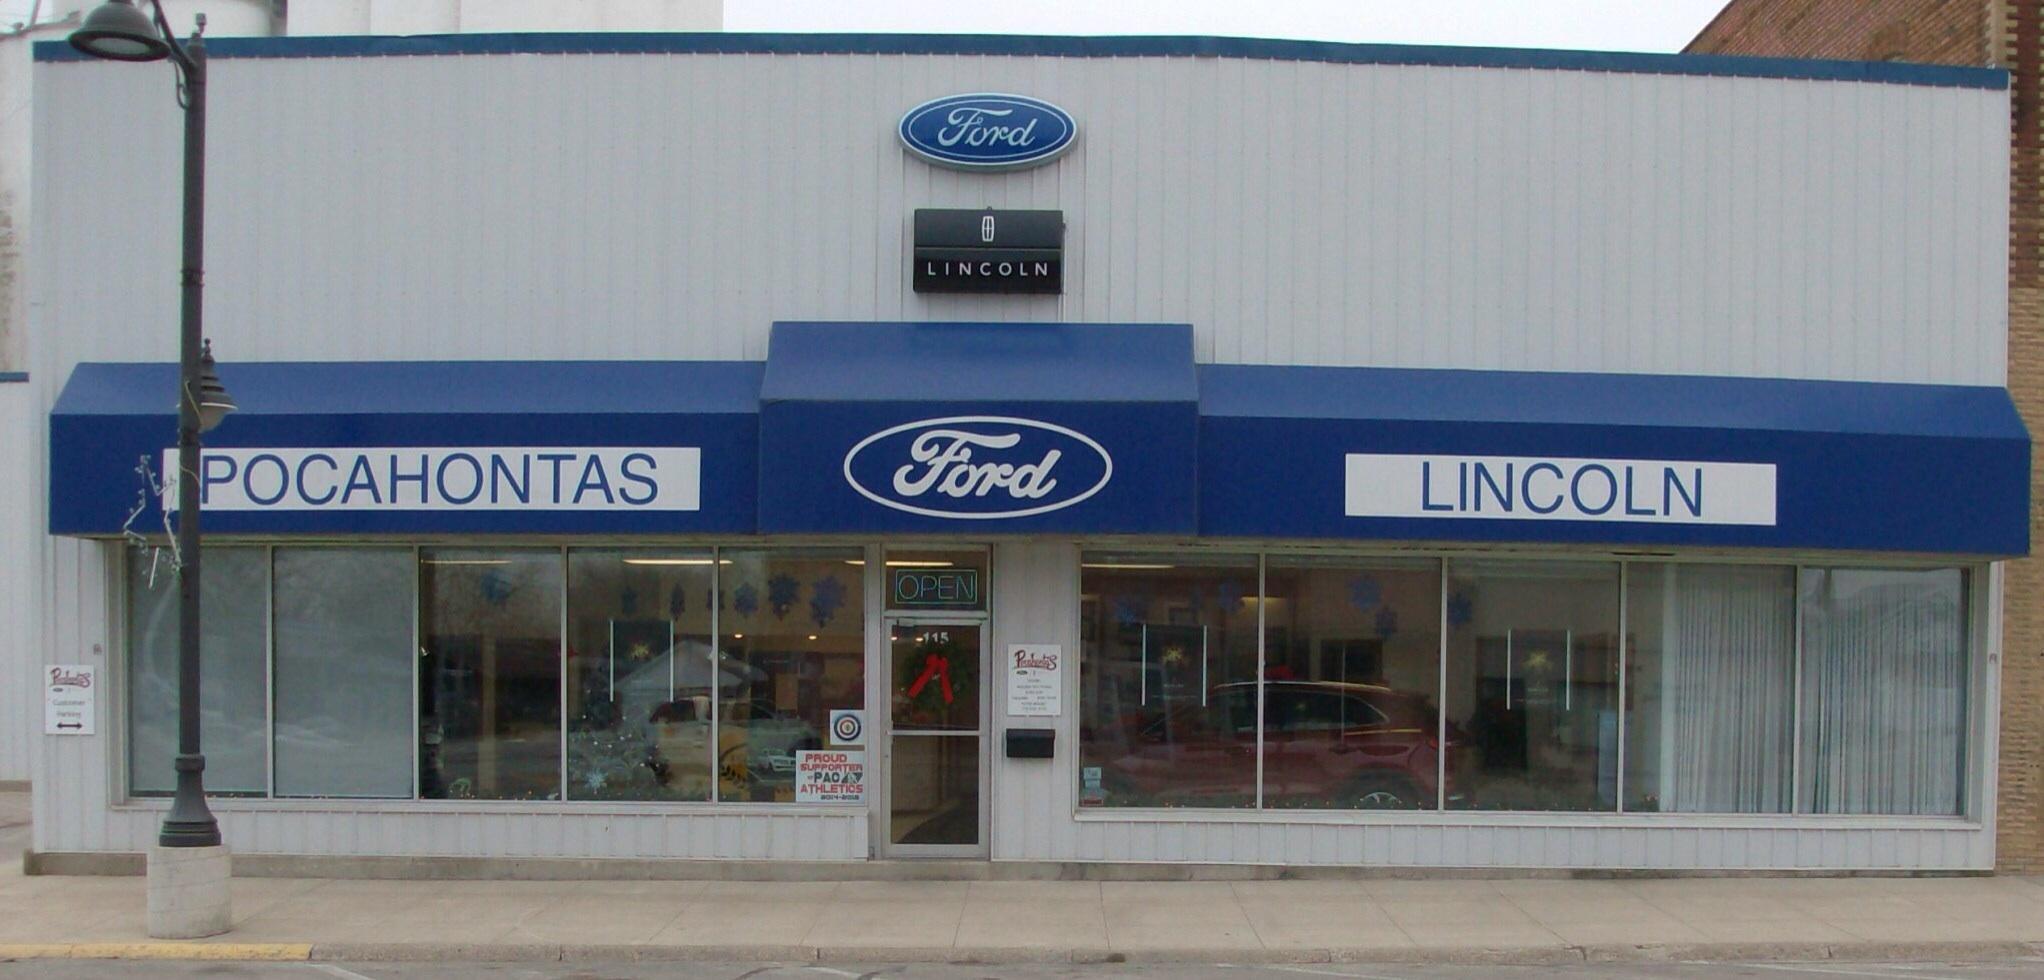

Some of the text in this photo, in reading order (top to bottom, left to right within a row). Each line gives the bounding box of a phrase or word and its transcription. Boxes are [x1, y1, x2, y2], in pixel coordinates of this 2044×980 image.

[937, 107, 1037, 148] Ford
[927, 261, 1049, 277] LINCOLN
[892, 429, 1062, 500] Ford
[200, 453, 659, 506] POCAHONTAS
[1421, 460, 1703, 517] LINCOLN
[898, 574, 974, 600] OPEN
[922, 631, 950, 645] 115
[800, 763, 863, 772] SUPPORTER
[804, 753, 848, 763] PROUD
[800, 783, 864, 795] ATHLETICS
